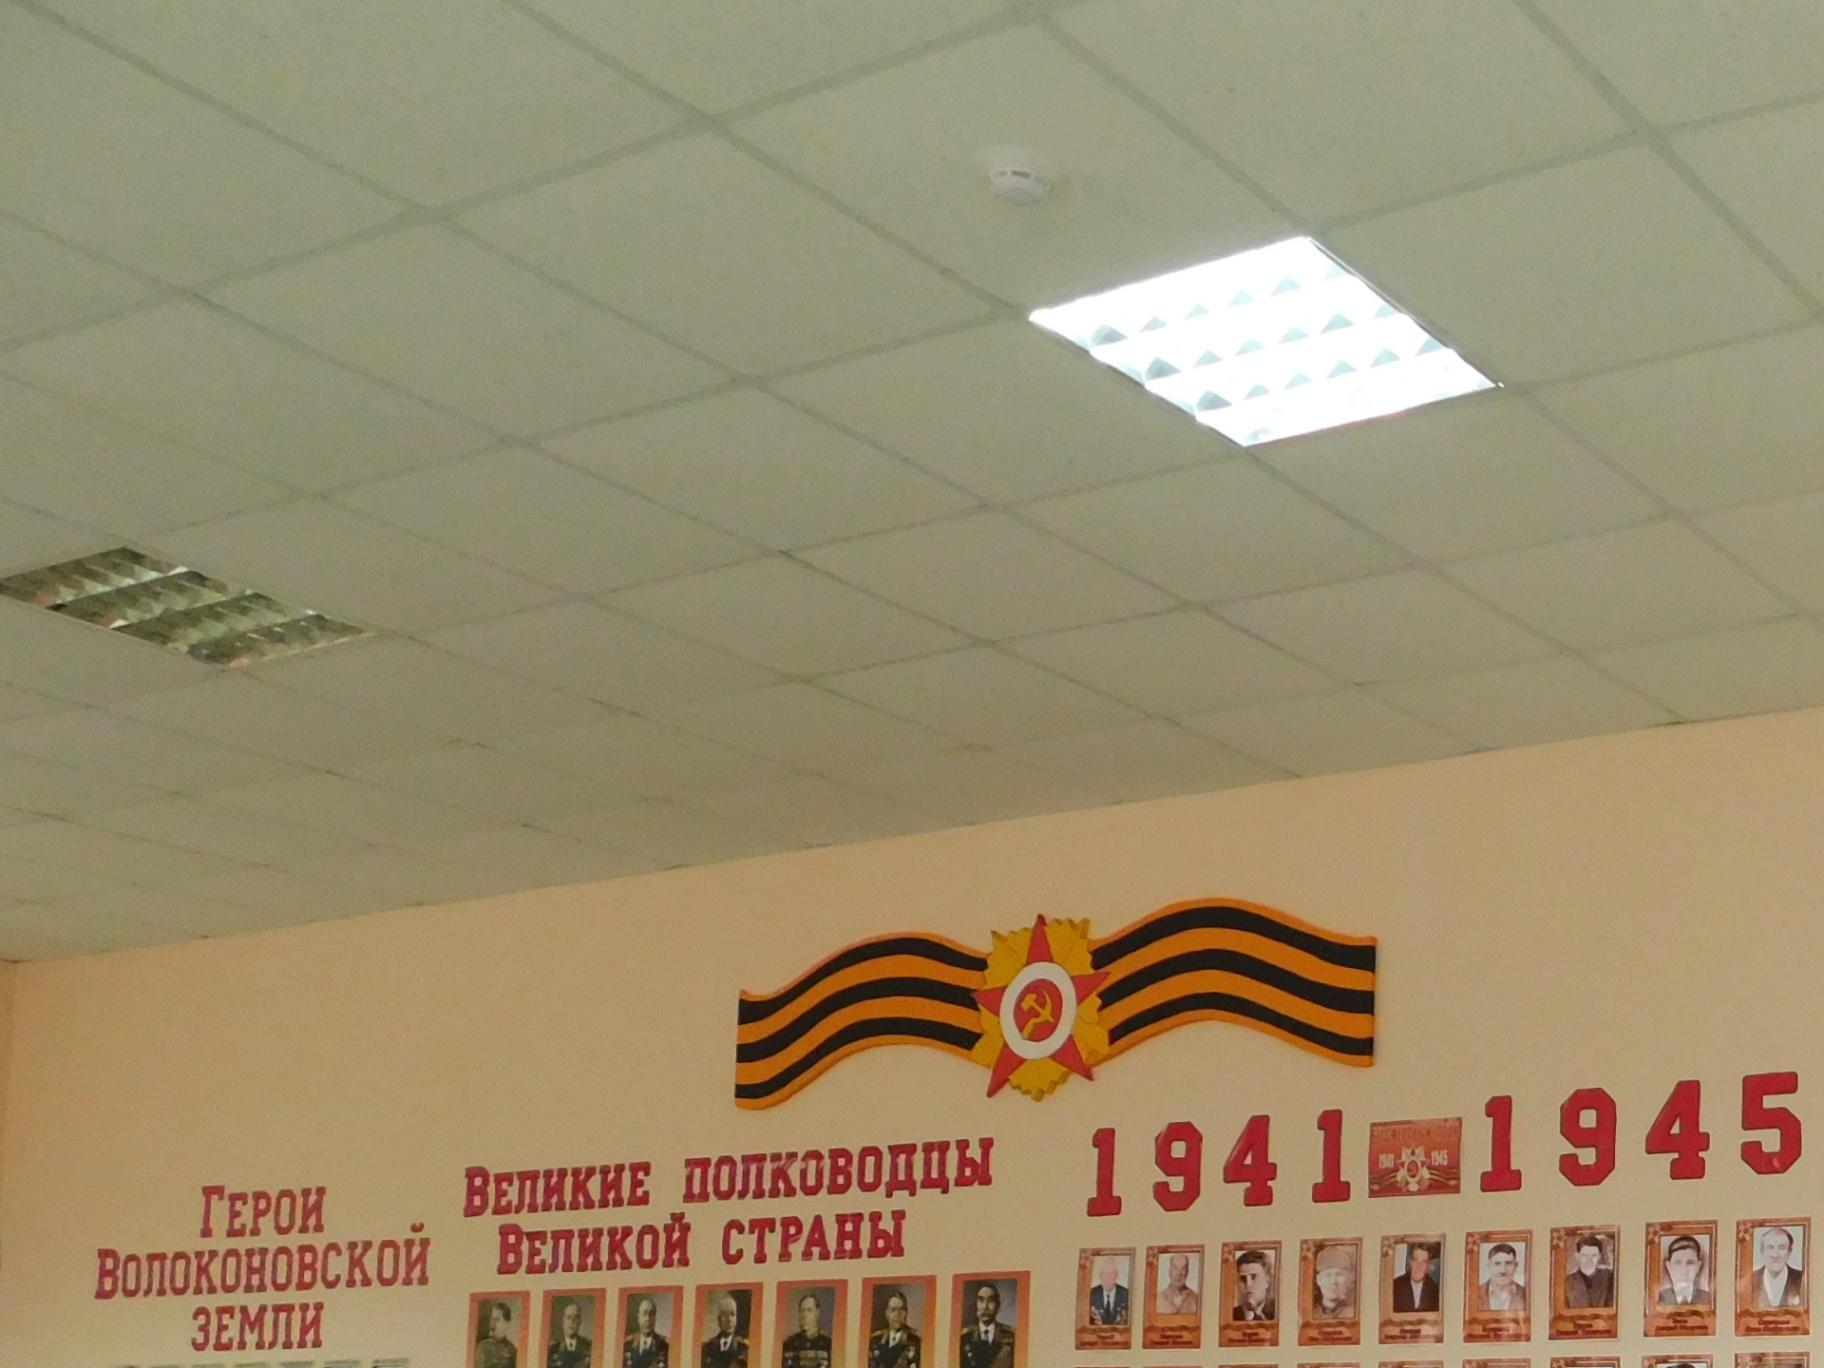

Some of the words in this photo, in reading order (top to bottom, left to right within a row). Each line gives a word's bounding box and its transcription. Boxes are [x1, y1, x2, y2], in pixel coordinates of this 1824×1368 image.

[464, 1160, 652, 1217] ВЕЛИКИЕ
[683, 1137, 995, 1203] ПОЛКОВОДЦЫ
[1087, 1108, 1352, 1217] 1941
[1480, 1071, 1803, 1193] 1945
[201, 1185, 326, 1239] ГЕРОИ
[496, 1211, 691, 1275] ВЕЛИКОЙ
[722, 1209, 906, 1265] СТРАНЫ
[95, 1222, 430, 1301] ВОЛОКОНОВСКОЙ
[191, 1302, 324, 1352] ЗЕМЛИ
